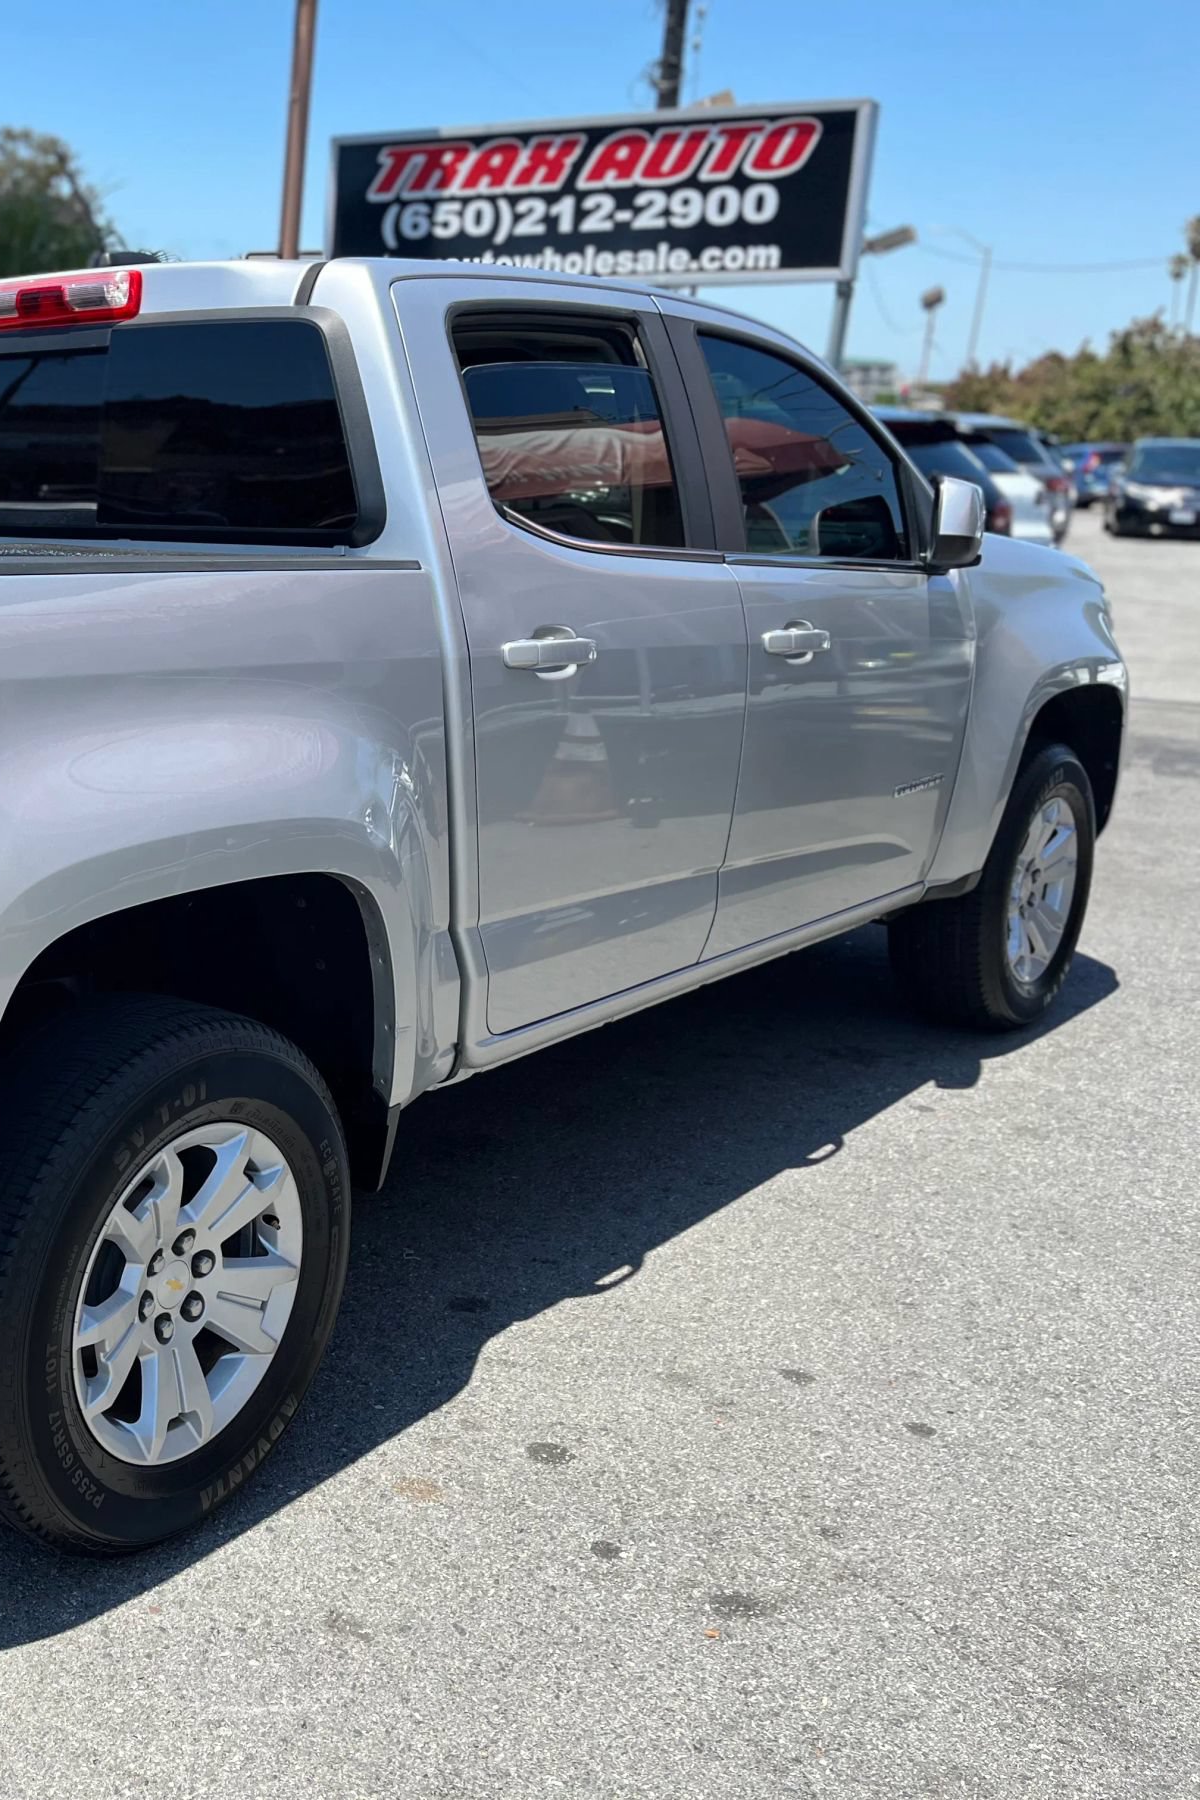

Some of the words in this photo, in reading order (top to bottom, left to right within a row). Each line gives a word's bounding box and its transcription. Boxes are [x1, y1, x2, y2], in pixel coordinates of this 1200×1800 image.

[366, 132, 588, 202] TRAX
[575, 116, 823, 191] AUTO
[381, 183, 780, 249] (650)212-2900
[45, 1343, 59, 1395] 110T
[47, 1410, 106, 1511] P255/65R17
[200, 1390, 299, 1513] ADVANTA
